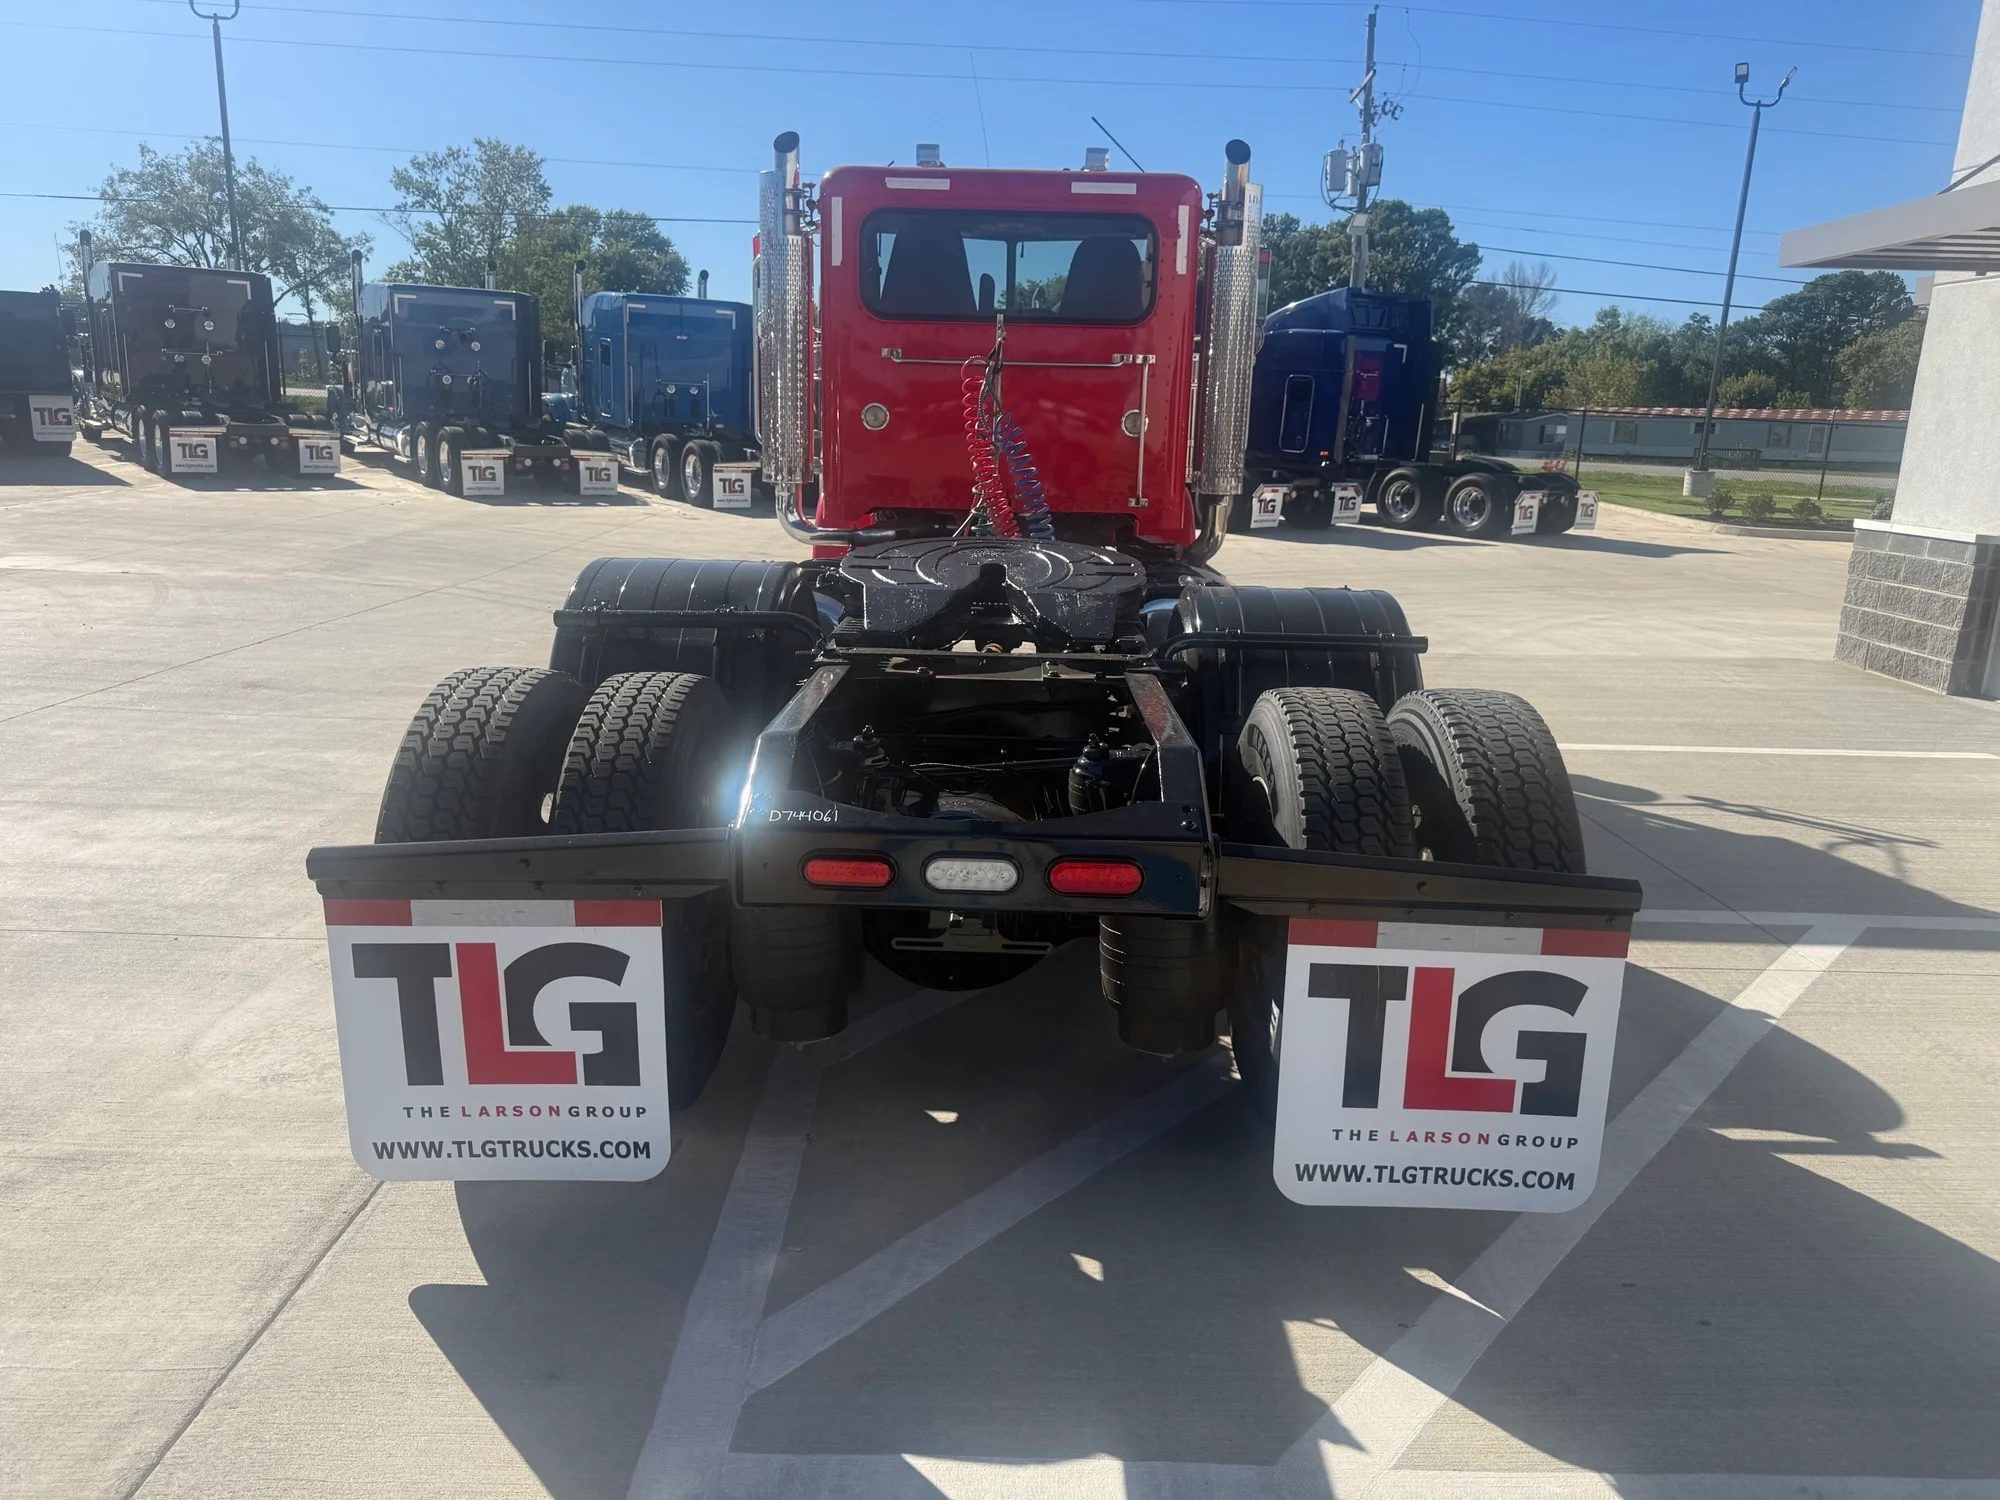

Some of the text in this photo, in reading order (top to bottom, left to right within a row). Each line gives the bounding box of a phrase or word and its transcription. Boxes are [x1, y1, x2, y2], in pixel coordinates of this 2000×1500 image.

[33, 407, 73, 426] TLG
[176, 442, 209, 460] TLG
[305, 445, 334, 461] TLG
[468, 466, 497, 482] TLG
[585, 466, 612, 482] TLG
[718, 478, 745, 494] TLG
[1257, 498, 1277, 515] TLG
[1338, 496, 1357, 511] TLG
[1580, 502, 1595, 518] TLG
[1517, 504, 1535, 521] TLG
[769, 808, 838, 822] D744061
[351, 942, 641, 1087] TLG
[1307, 962, 1589, 1117] TLG
[403, 1105, 648, 1118] THE LARSON GROUP
[1332, 1128, 1579, 1149] THE LARSON GROUP
[372, 1140, 651, 1160] WWW.TLGTRUCKS.COM
[1294, 1163, 1575, 1191] WWW.TLGTRUCKS.COM
